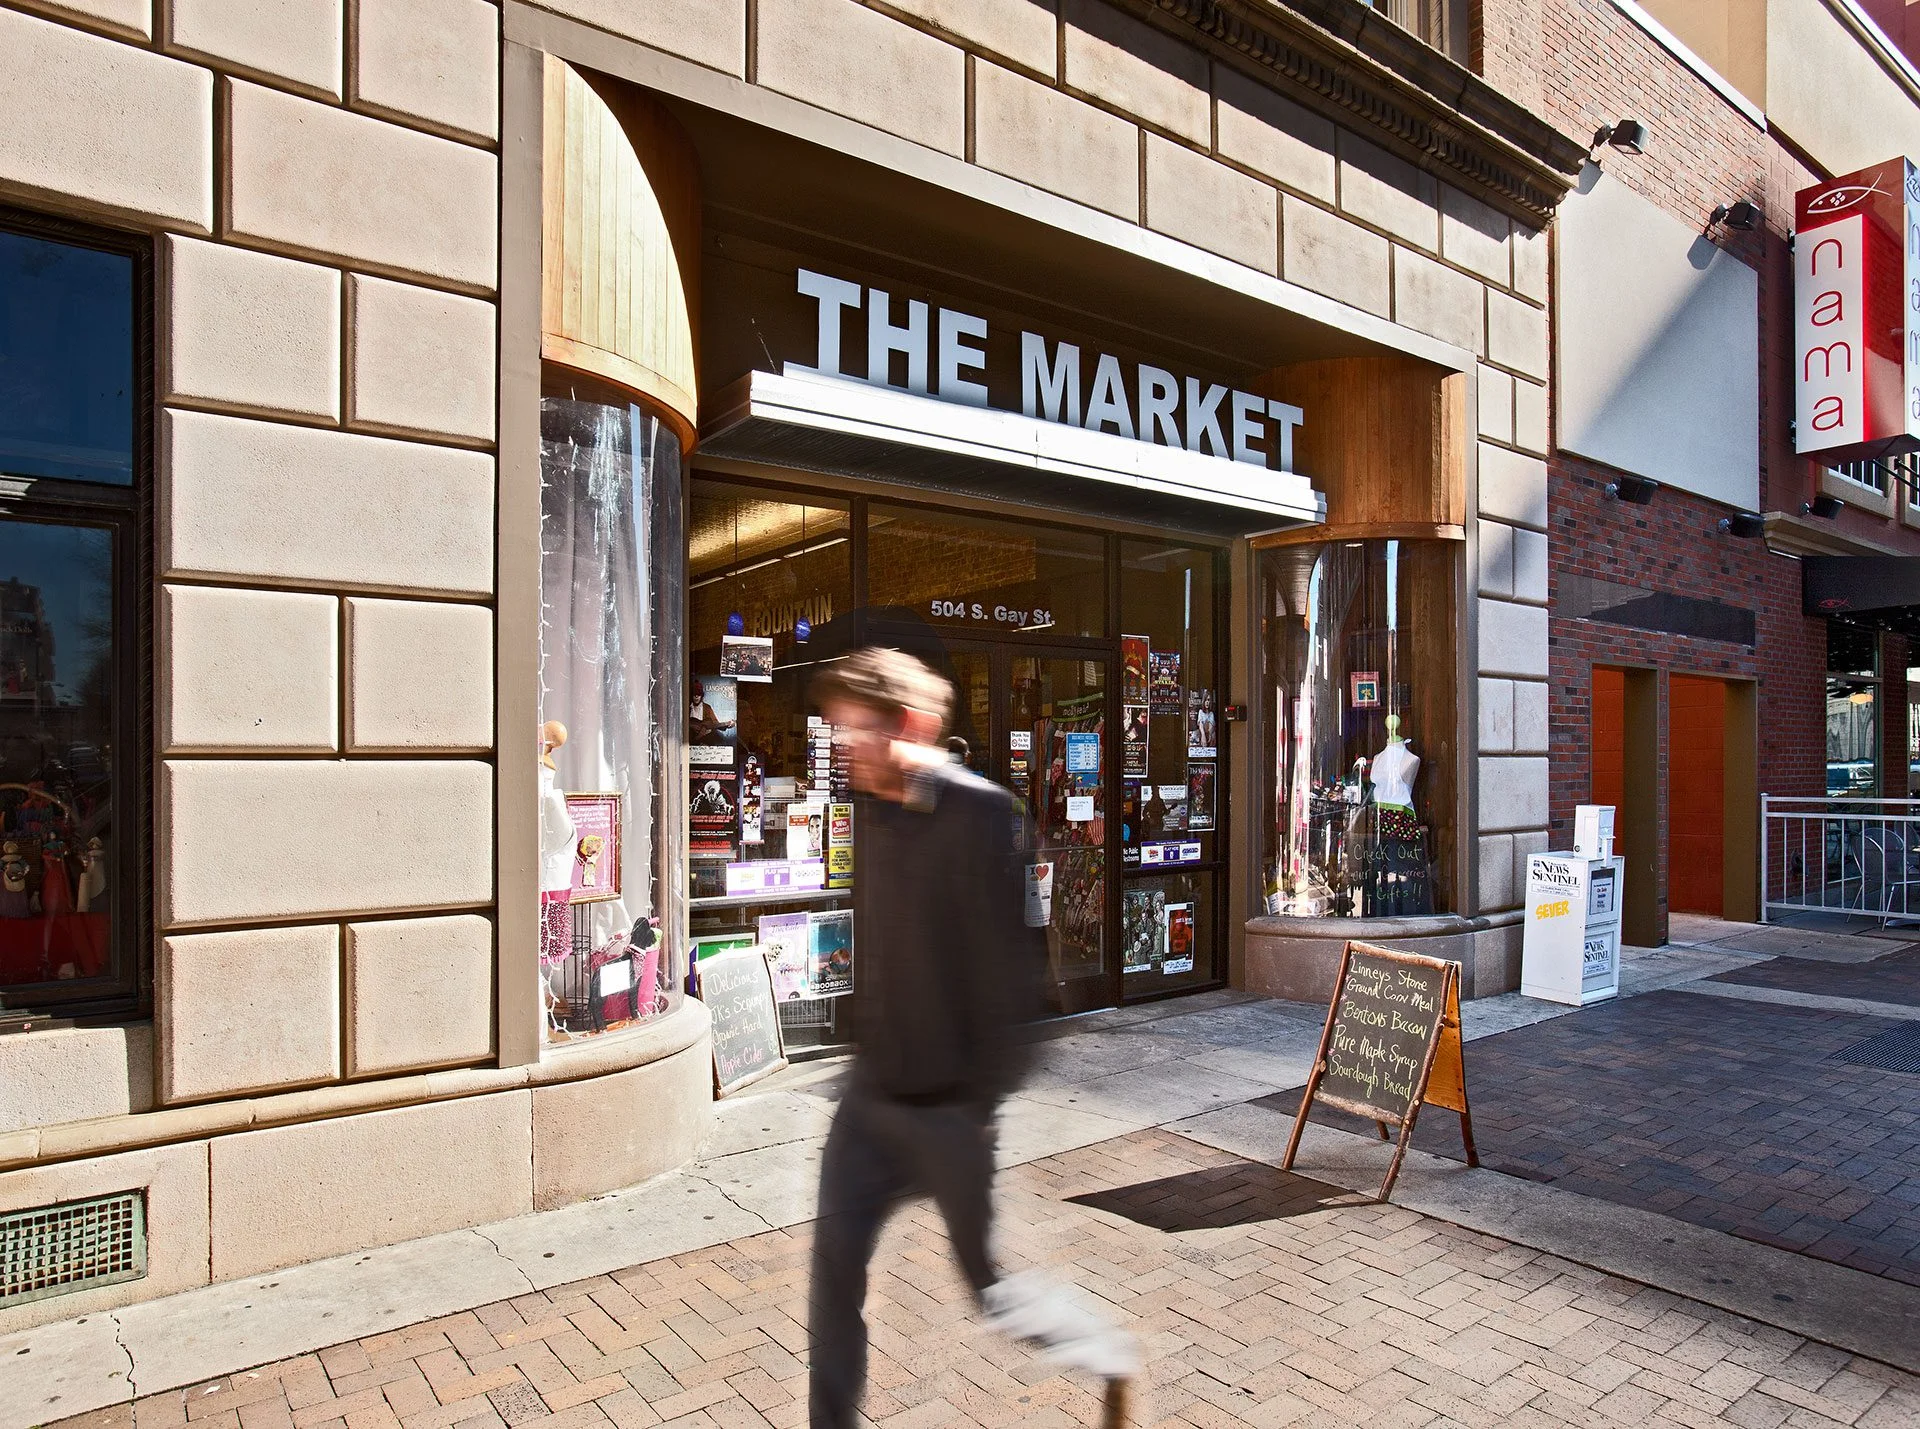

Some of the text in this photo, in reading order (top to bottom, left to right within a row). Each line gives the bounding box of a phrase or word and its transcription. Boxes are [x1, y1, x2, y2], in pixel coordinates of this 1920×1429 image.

[1803, 238, 1851, 431] nama
[797, 268, 1304, 474] THE MARKET
[753, 593, 832, 637] FOUNTAIN
[931, 600, 1056, 626] 504 S. Gay St.
[1532, 869, 1580, 886] SENTINEL
[1541, 860, 1569, 875] NEWS
[1535, 900, 1570, 920] SEVER
[1584, 950, 1609, 963] SENTINEL
[1589, 941, 1604, 953] NEWS
[709, 969, 758, 996] Delicious
[1351, 959, 1428, 991] Linneys Stone
[1347, 978, 1434, 1013] Ground Corn Meal
[712, 1026, 740, 1050] Organic
[742, 1013, 764, 1034] Hard
[1343, 1001, 1427, 1040] Bentons Bacon
[721, 1054, 741, 1076] Apple
[743, 1043, 764, 1065] Cider
[1333, 1024, 1418, 1080] Pure Maple Syrup
[1329, 1054, 1412, 1101] Sourdough Bread
